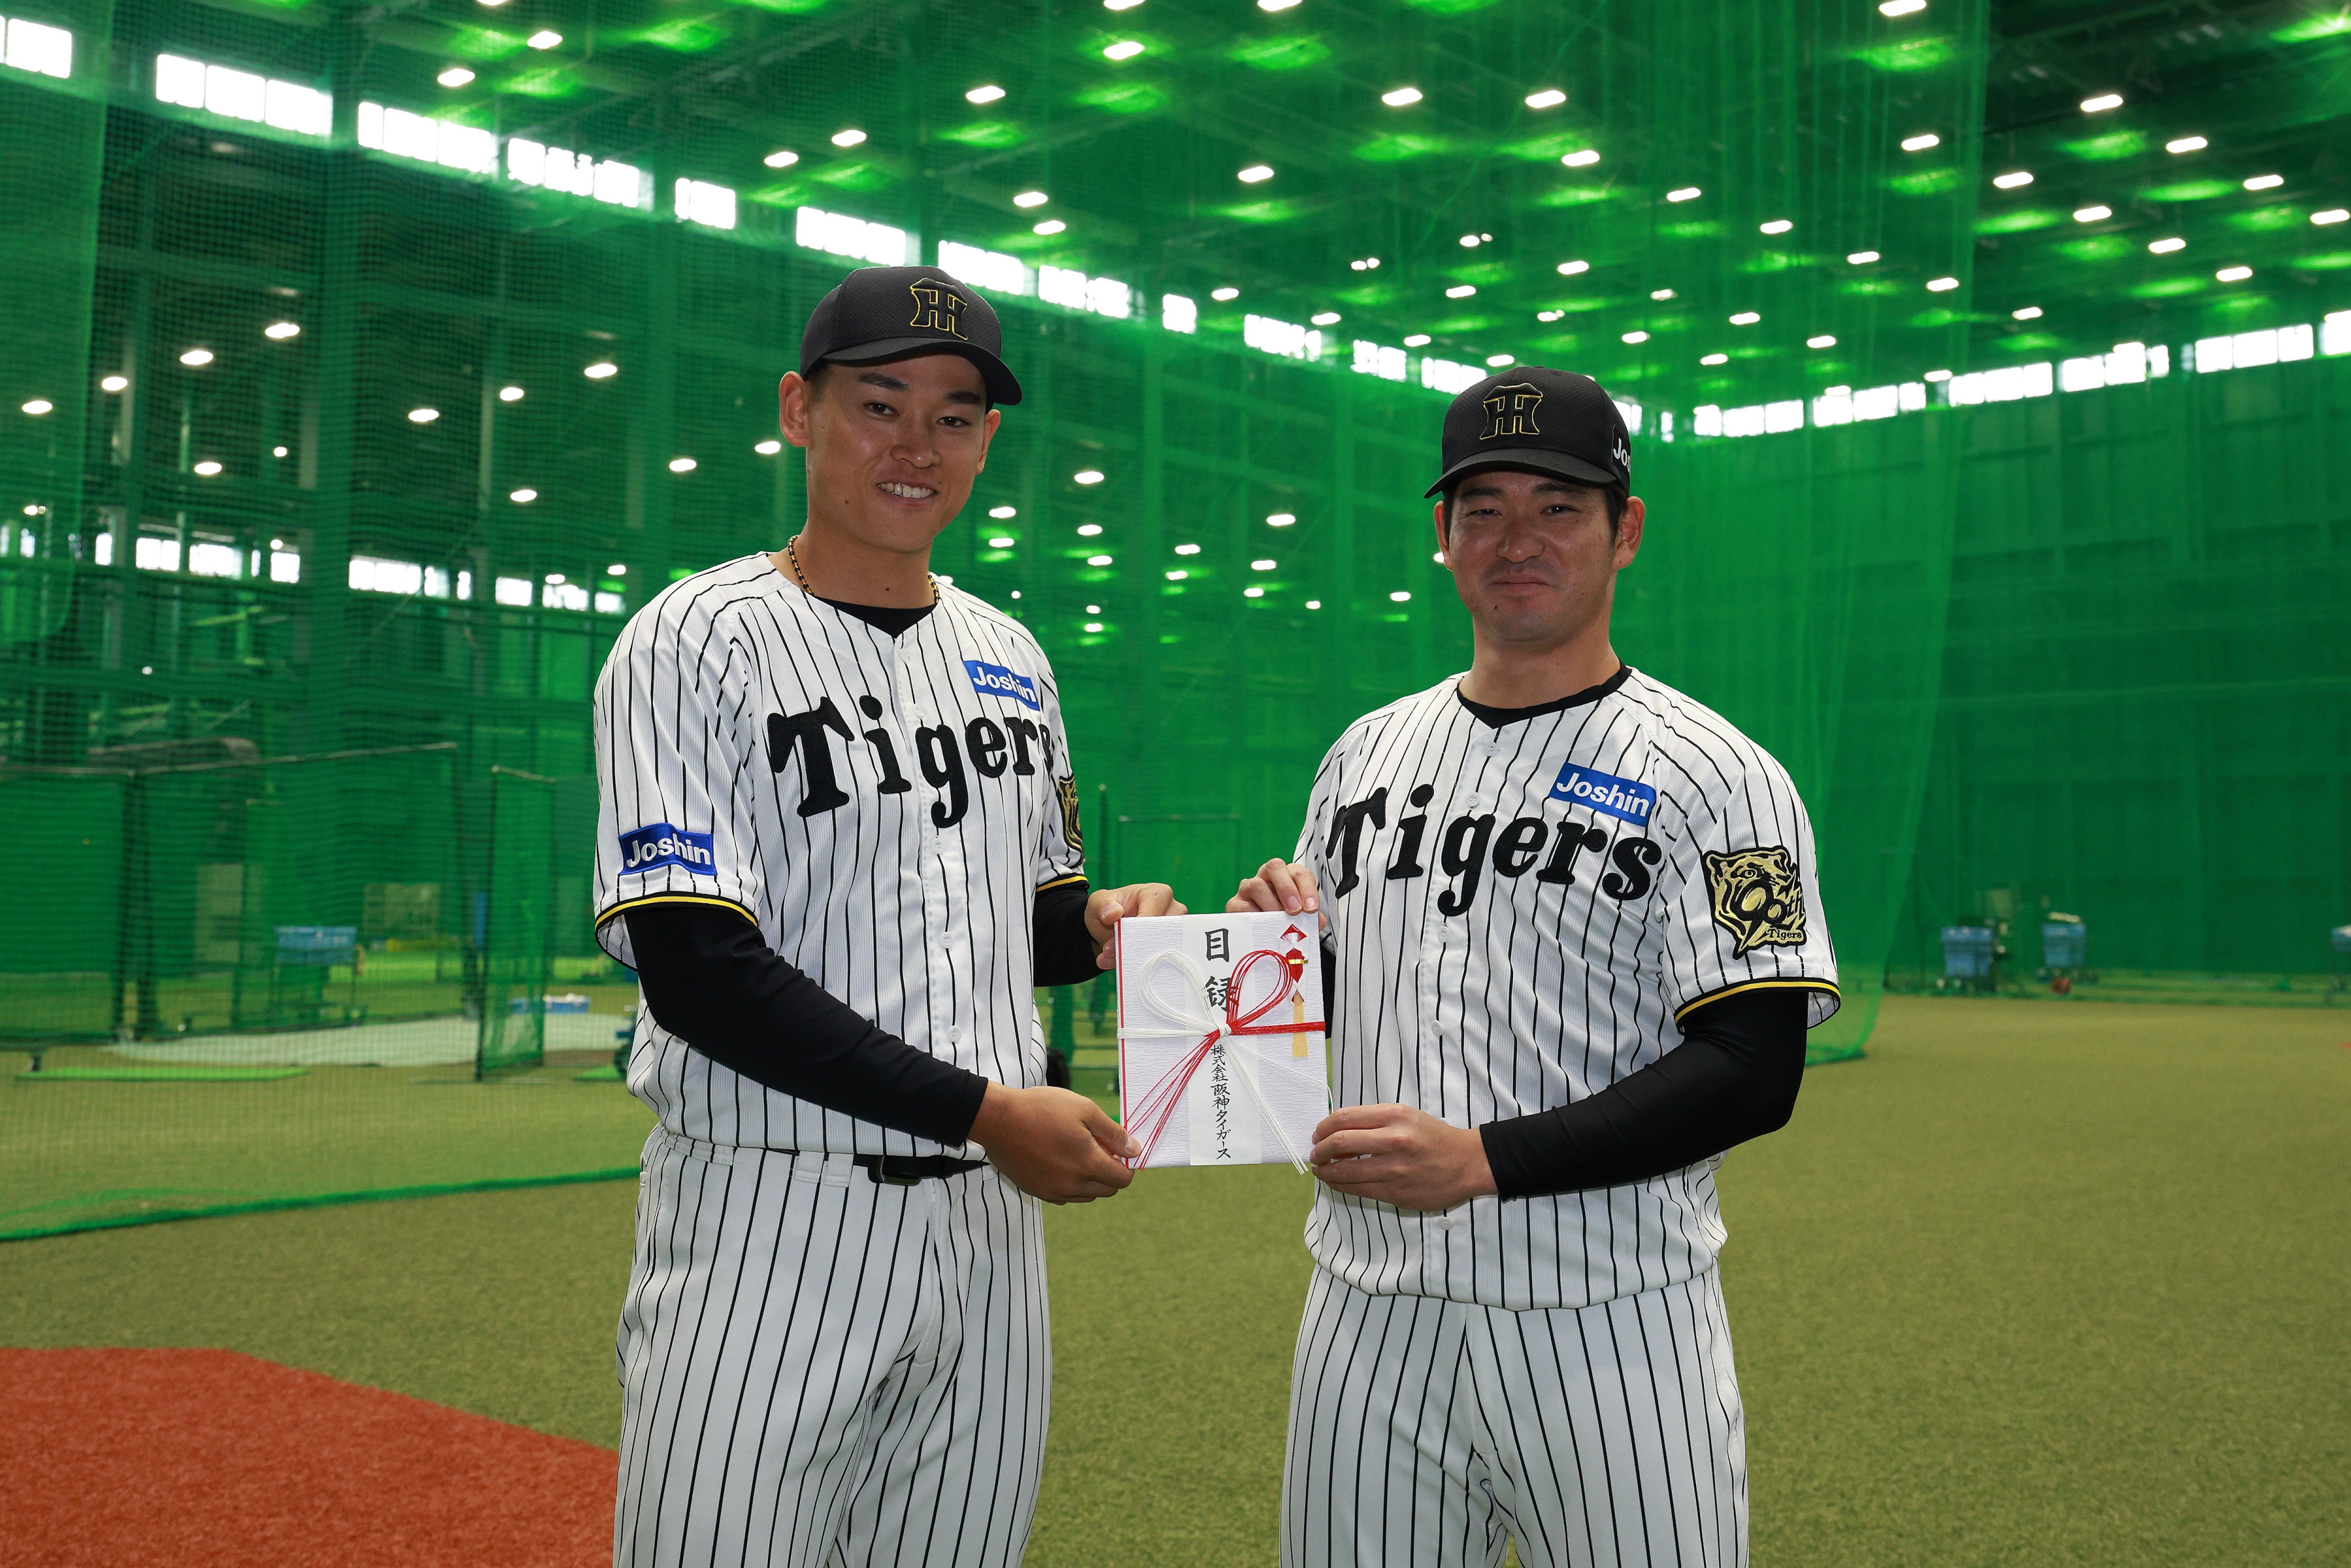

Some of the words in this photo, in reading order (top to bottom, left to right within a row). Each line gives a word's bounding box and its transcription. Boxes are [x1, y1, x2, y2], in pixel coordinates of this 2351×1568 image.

[972, 666, 1037, 703] Joshin
[1556, 772, 1650, 817] Joshin
[626, 833, 711, 868] Joshin
[1326, 783, 1663, 917] Tigers
[1767, 929, 1802, 941] Tigers
[1209, 1043, 1232, 1160] 株式会社阪神タイガース
